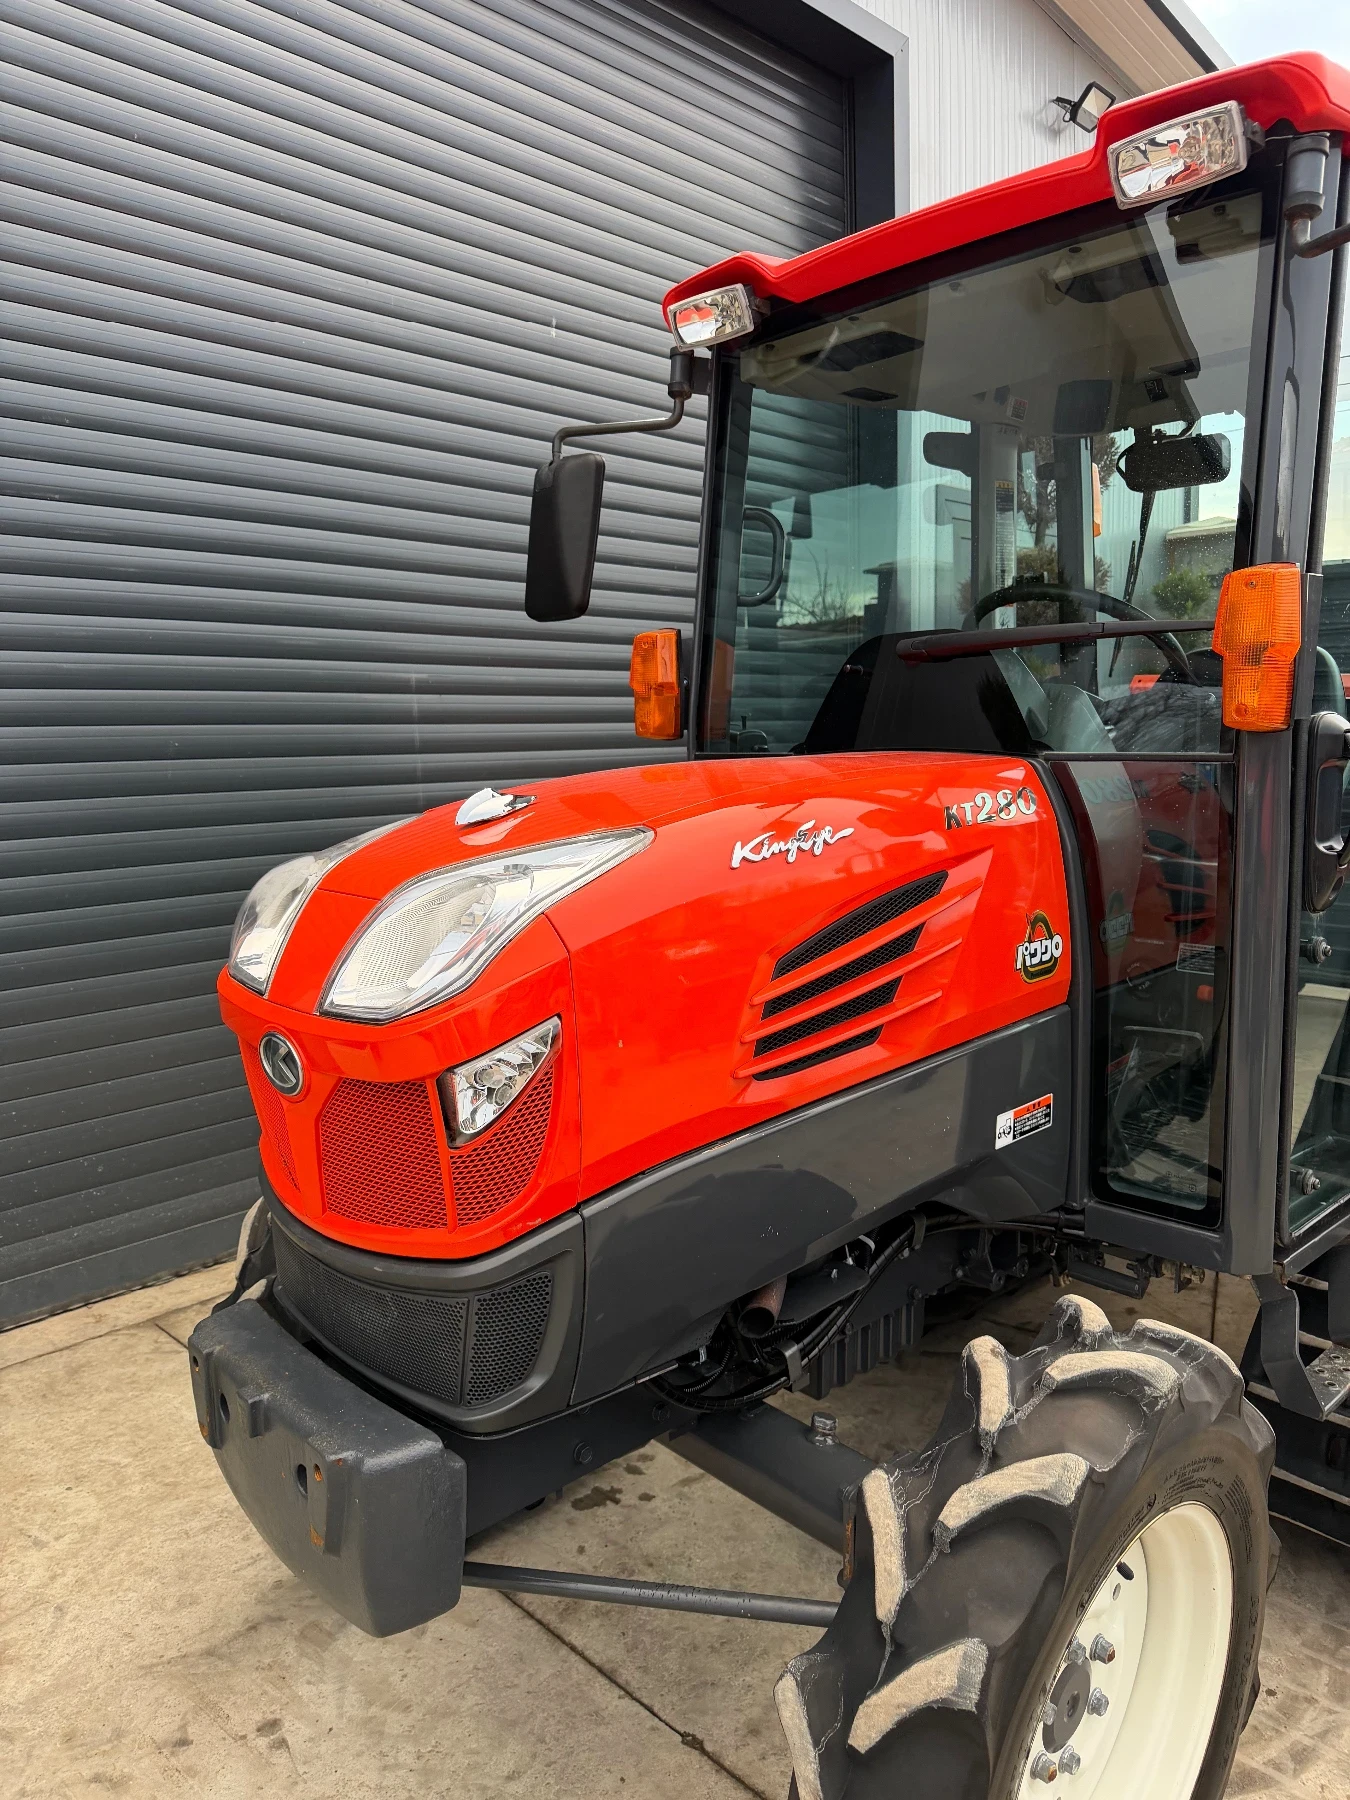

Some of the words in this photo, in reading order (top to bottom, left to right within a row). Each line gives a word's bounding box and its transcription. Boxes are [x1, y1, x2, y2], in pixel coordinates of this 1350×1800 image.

[944, 787, 1038, 830] KT280
[1015, 933, 1063, 972] パワクロ
